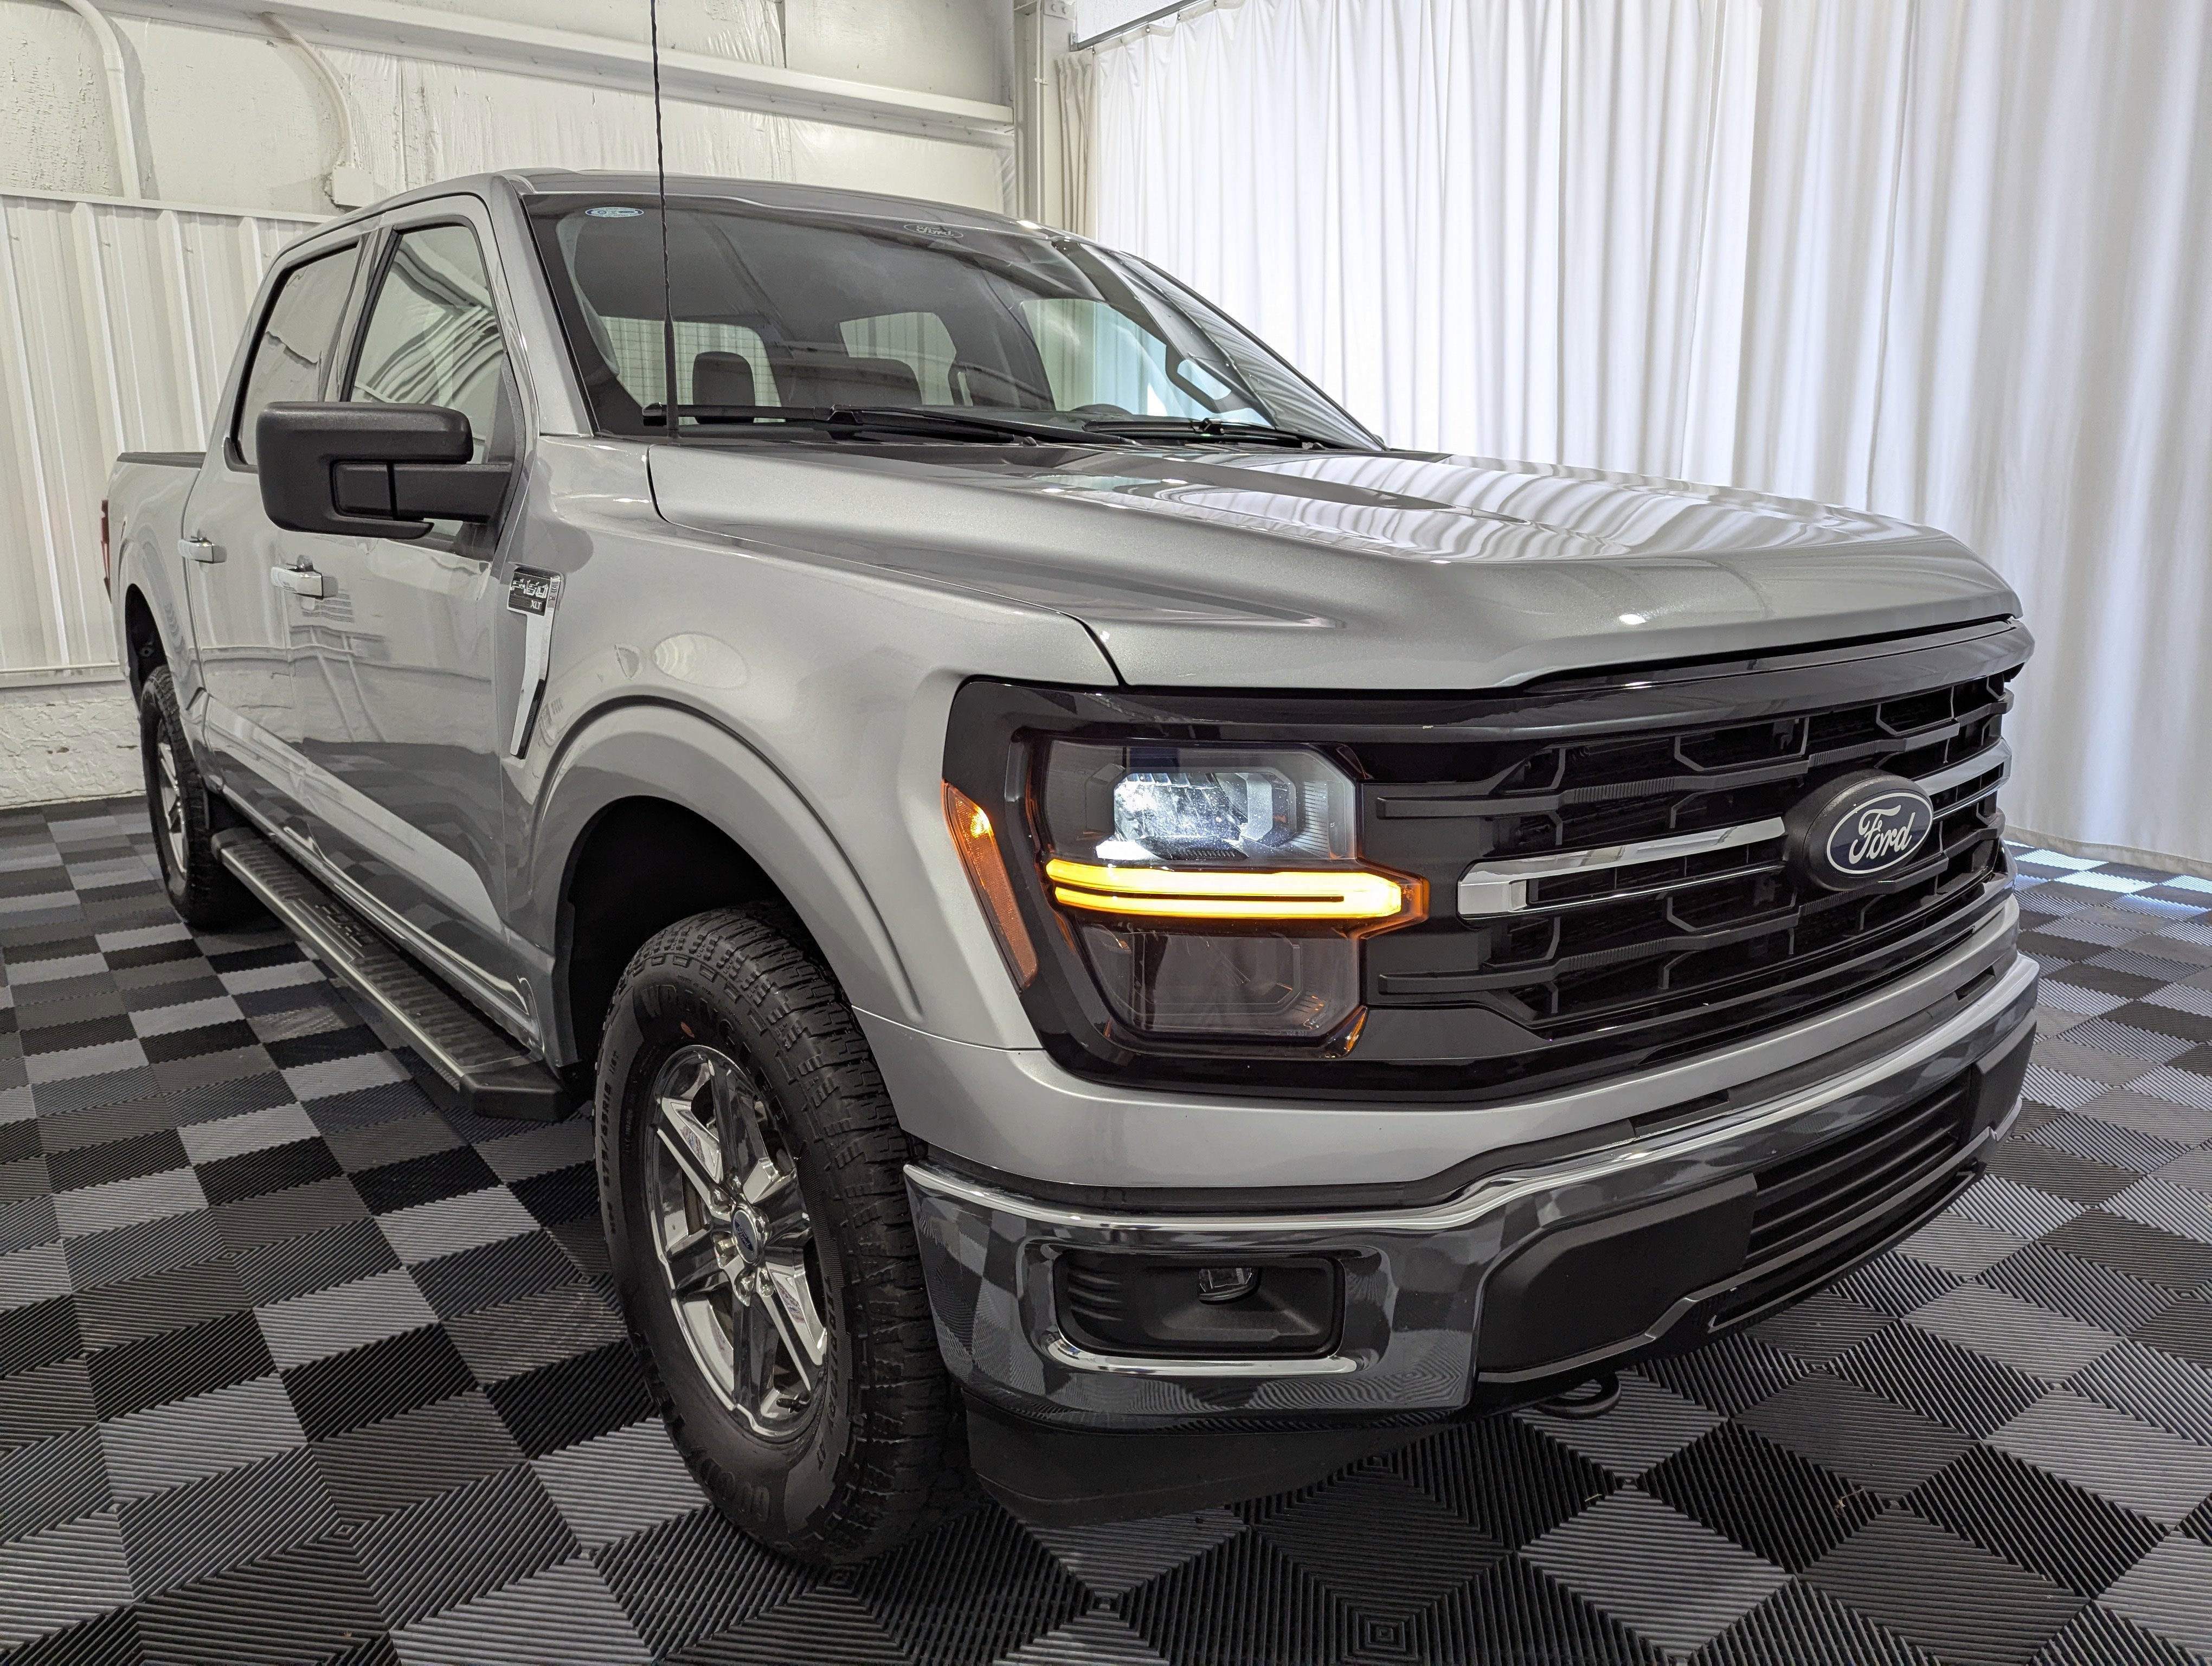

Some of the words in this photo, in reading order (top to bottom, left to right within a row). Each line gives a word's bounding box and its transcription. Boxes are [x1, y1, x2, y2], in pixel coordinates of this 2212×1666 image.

[916, 225, 954, 237] Ford
[510, 578, 549, 599] F-150
[530, 599, 542, 610] XLT
[1848, 804, 1915, 864] Ford
[737, 1225, 751, 1248] Ford
